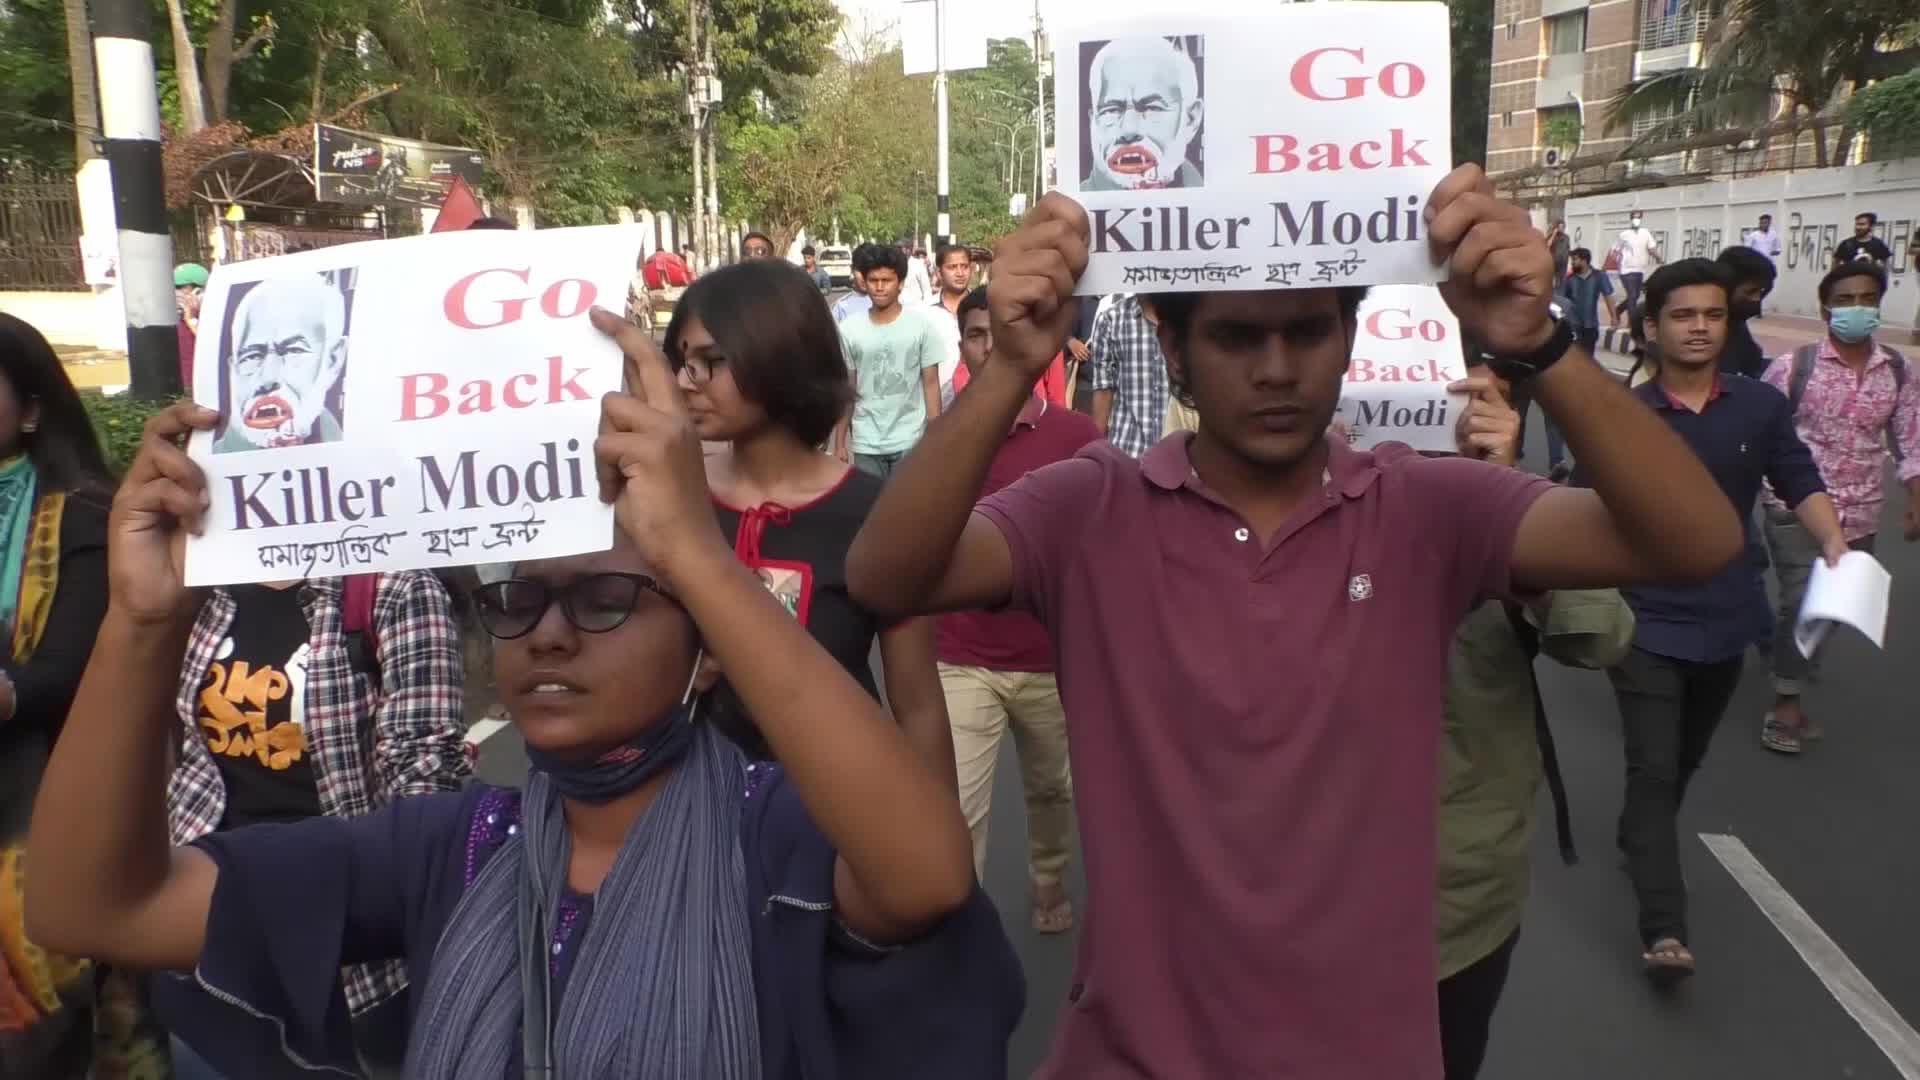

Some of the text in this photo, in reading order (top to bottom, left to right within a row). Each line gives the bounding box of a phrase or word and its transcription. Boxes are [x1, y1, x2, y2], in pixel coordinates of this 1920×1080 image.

[1289, 47, 1426, 101] Go
[1248, 127, 1432, 175] Back
[1089, 195, 1421, 253] Killer Modi
[443, 266, 598, 330] Go
[1366, 308, 1446, 342] Go
[392, 355, 594, 423] Back
[1346, 358, 1454, 383] Back
[1353, 399, 1448, 427] Modi
[225, 438, 588, 531] Killer Modi
